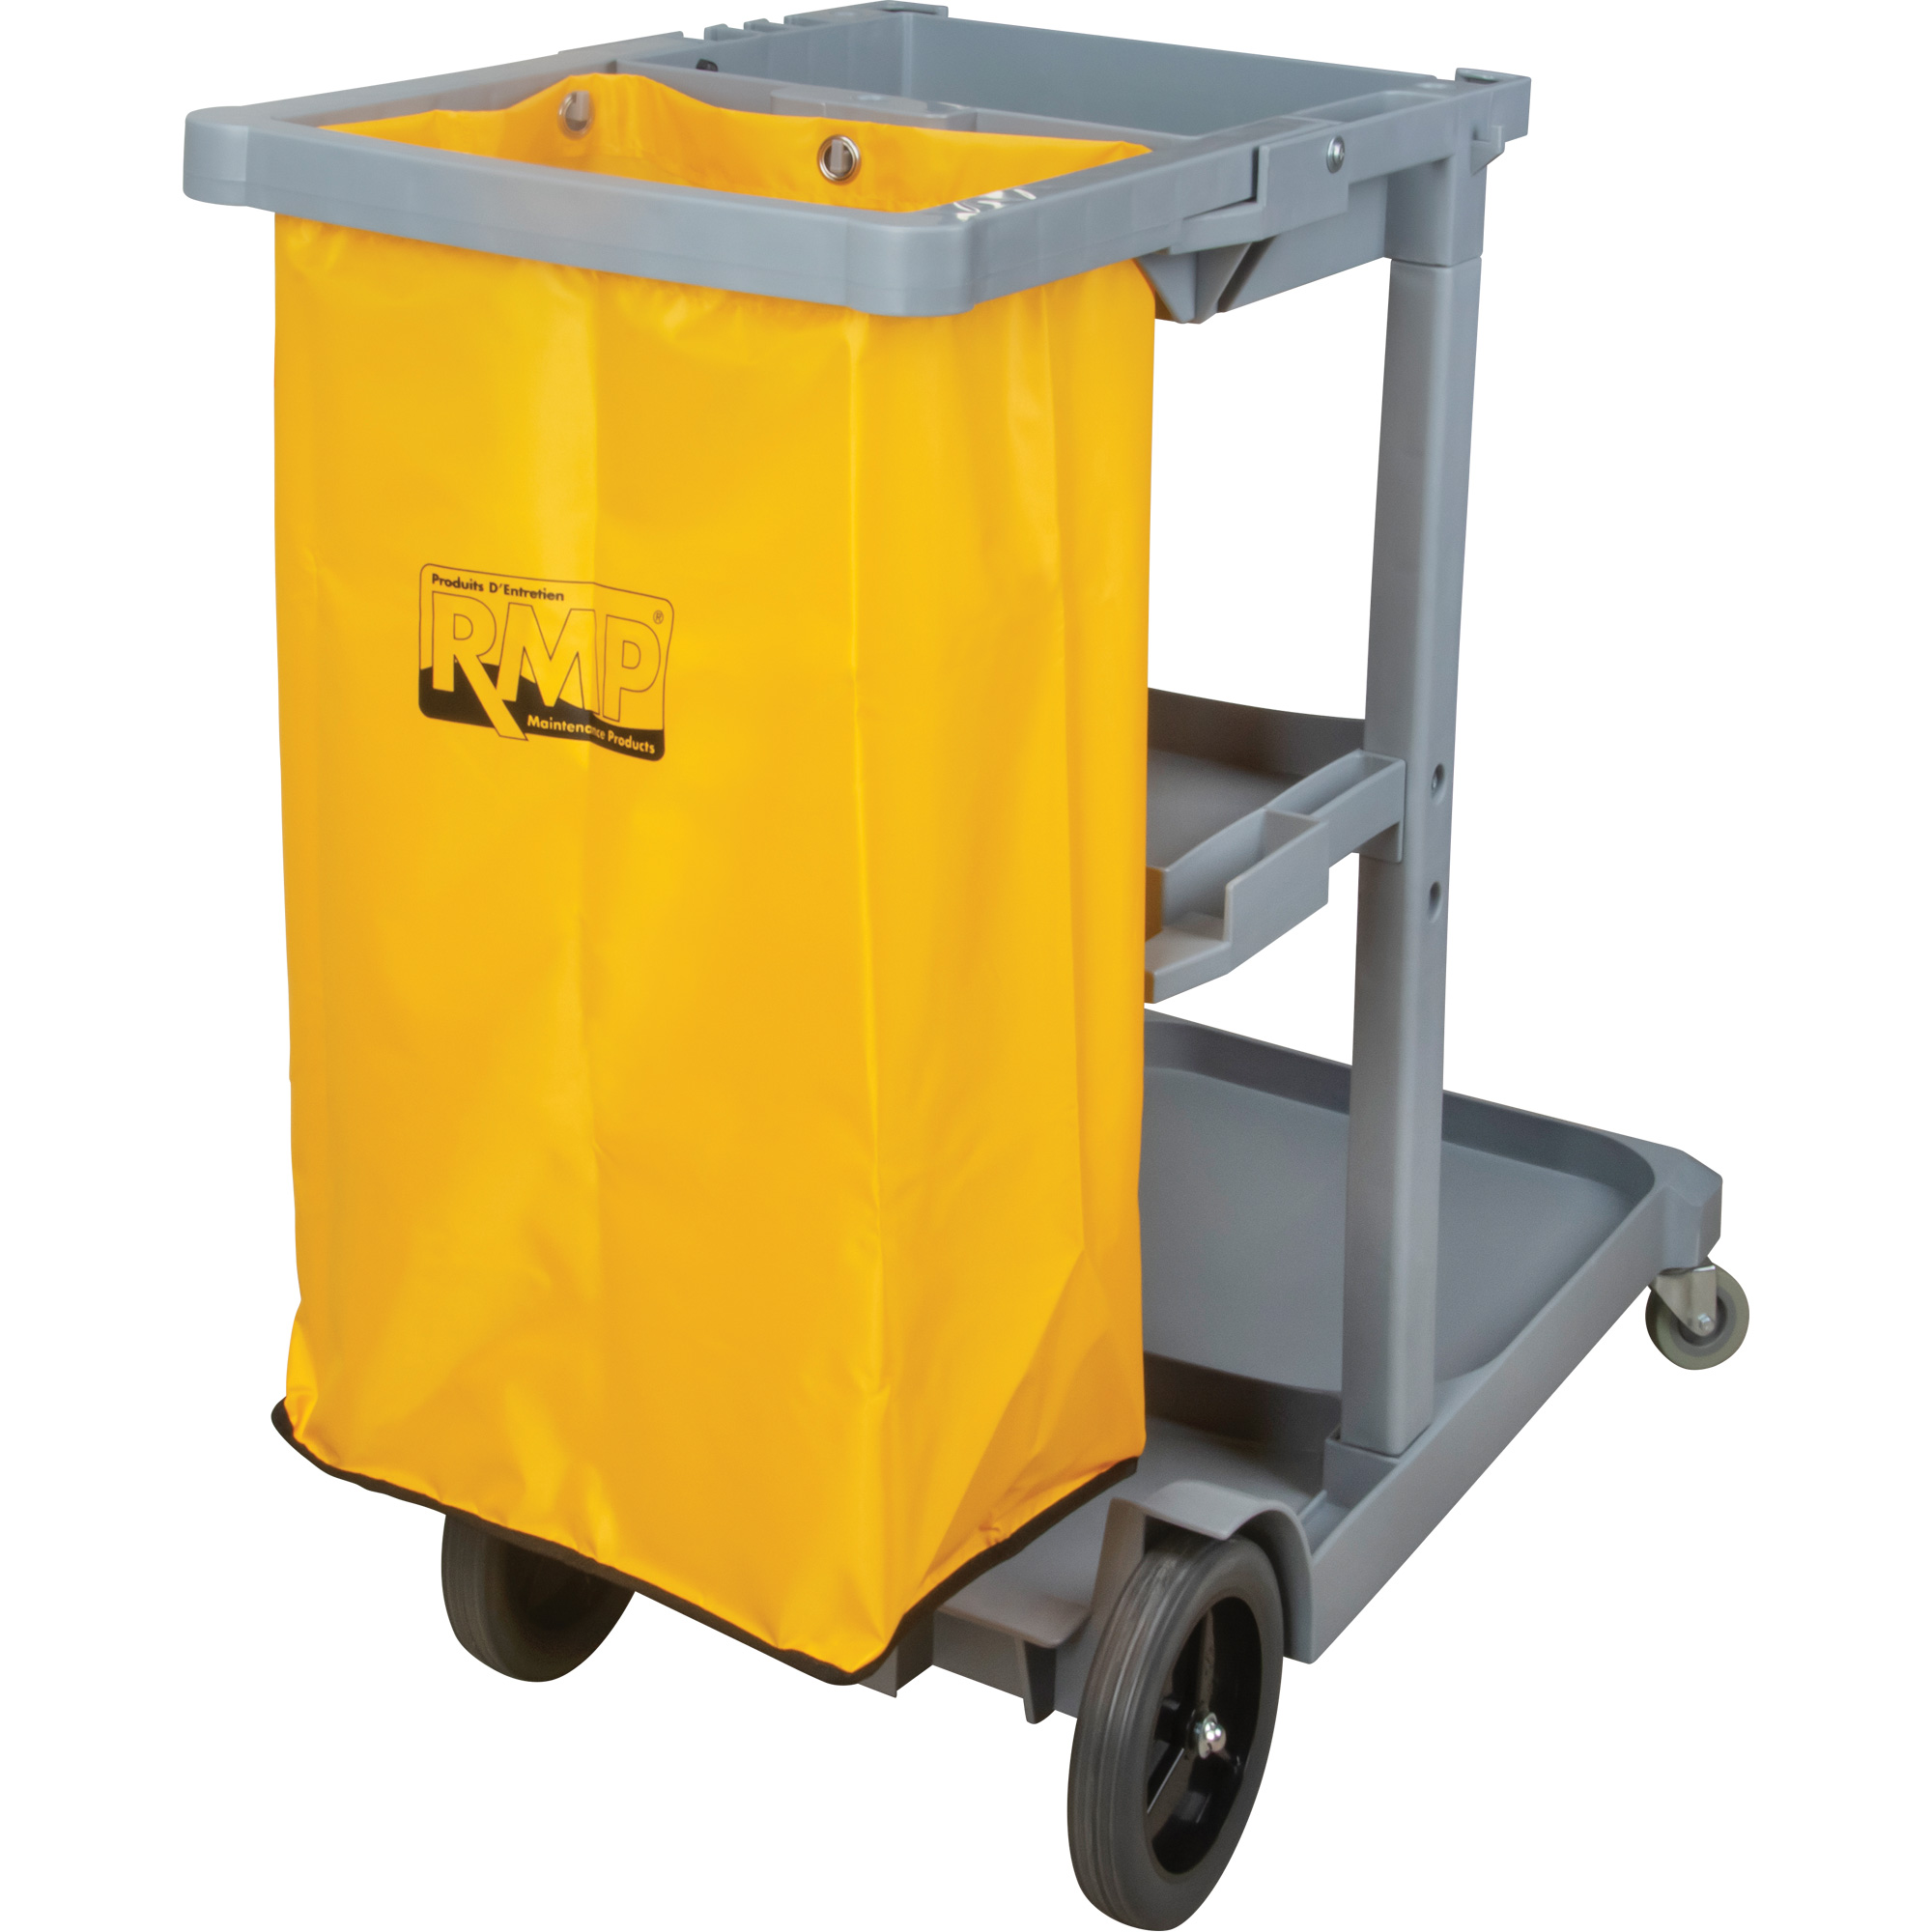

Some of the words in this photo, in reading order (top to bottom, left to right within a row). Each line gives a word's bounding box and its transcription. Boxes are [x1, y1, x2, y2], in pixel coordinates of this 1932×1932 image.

[432, 573, 484, 592] Produits
[489, 582, 565, 602] D'Entretien
[431, 590, 662, 741] RMP
[526, 714, 606, 741] Maintenance
[608, 729, 656, 754] Products
